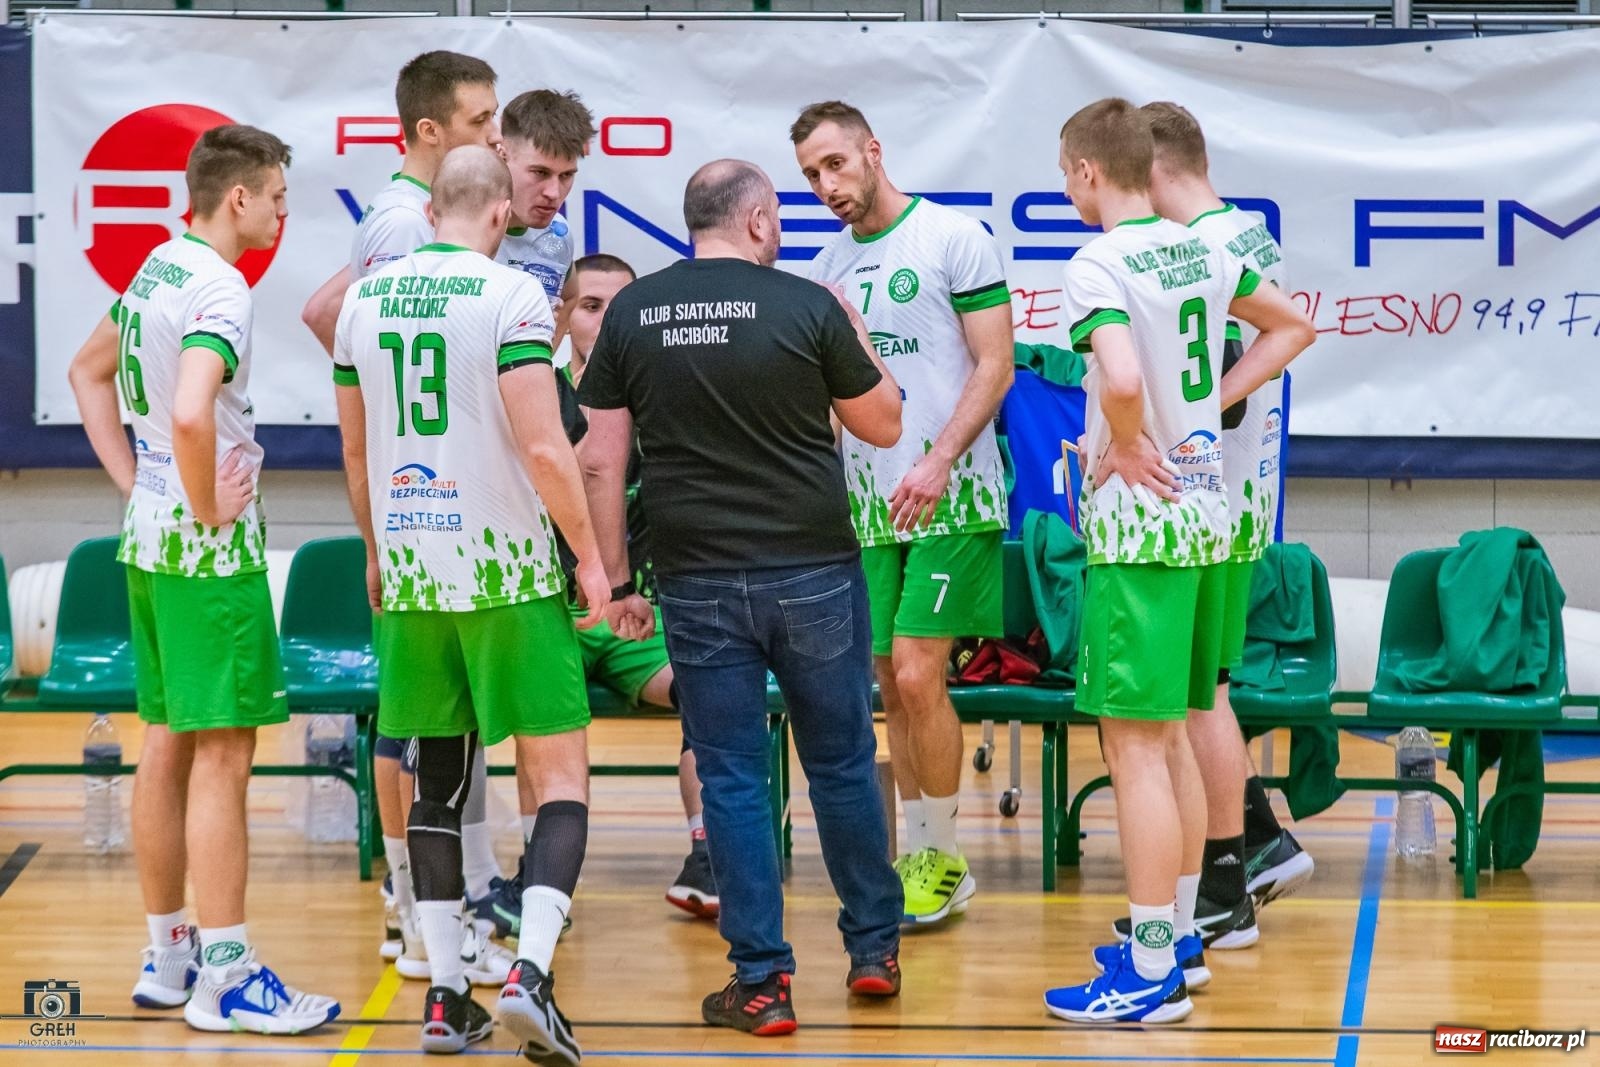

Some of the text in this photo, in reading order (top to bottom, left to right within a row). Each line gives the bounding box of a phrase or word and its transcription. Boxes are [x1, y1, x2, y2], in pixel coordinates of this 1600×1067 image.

[1354, 199, 1600, 267] FM
[1121, 250, 1160, 275] KLUB
[357, 276, 395, 299] KLUB
[860, 281, 874, 315] 7
[379, 296, 450, 319] RACIÓRZ
[640, 300, 756, 327] KLUB SIATKARSKI
[1473, 298, 1546, 335] 94,9
[1558, 292, 1600, 336] F
[662, 323, 729, 348] RACIBÓRZ
[1179, 296, 1214, 403] 3
[118, 305, 149, 416] 16
[378, 332, 449, 437] 13
[385, 512, 462, 531] ENTECO
[930, 572, 951, 614] 7
